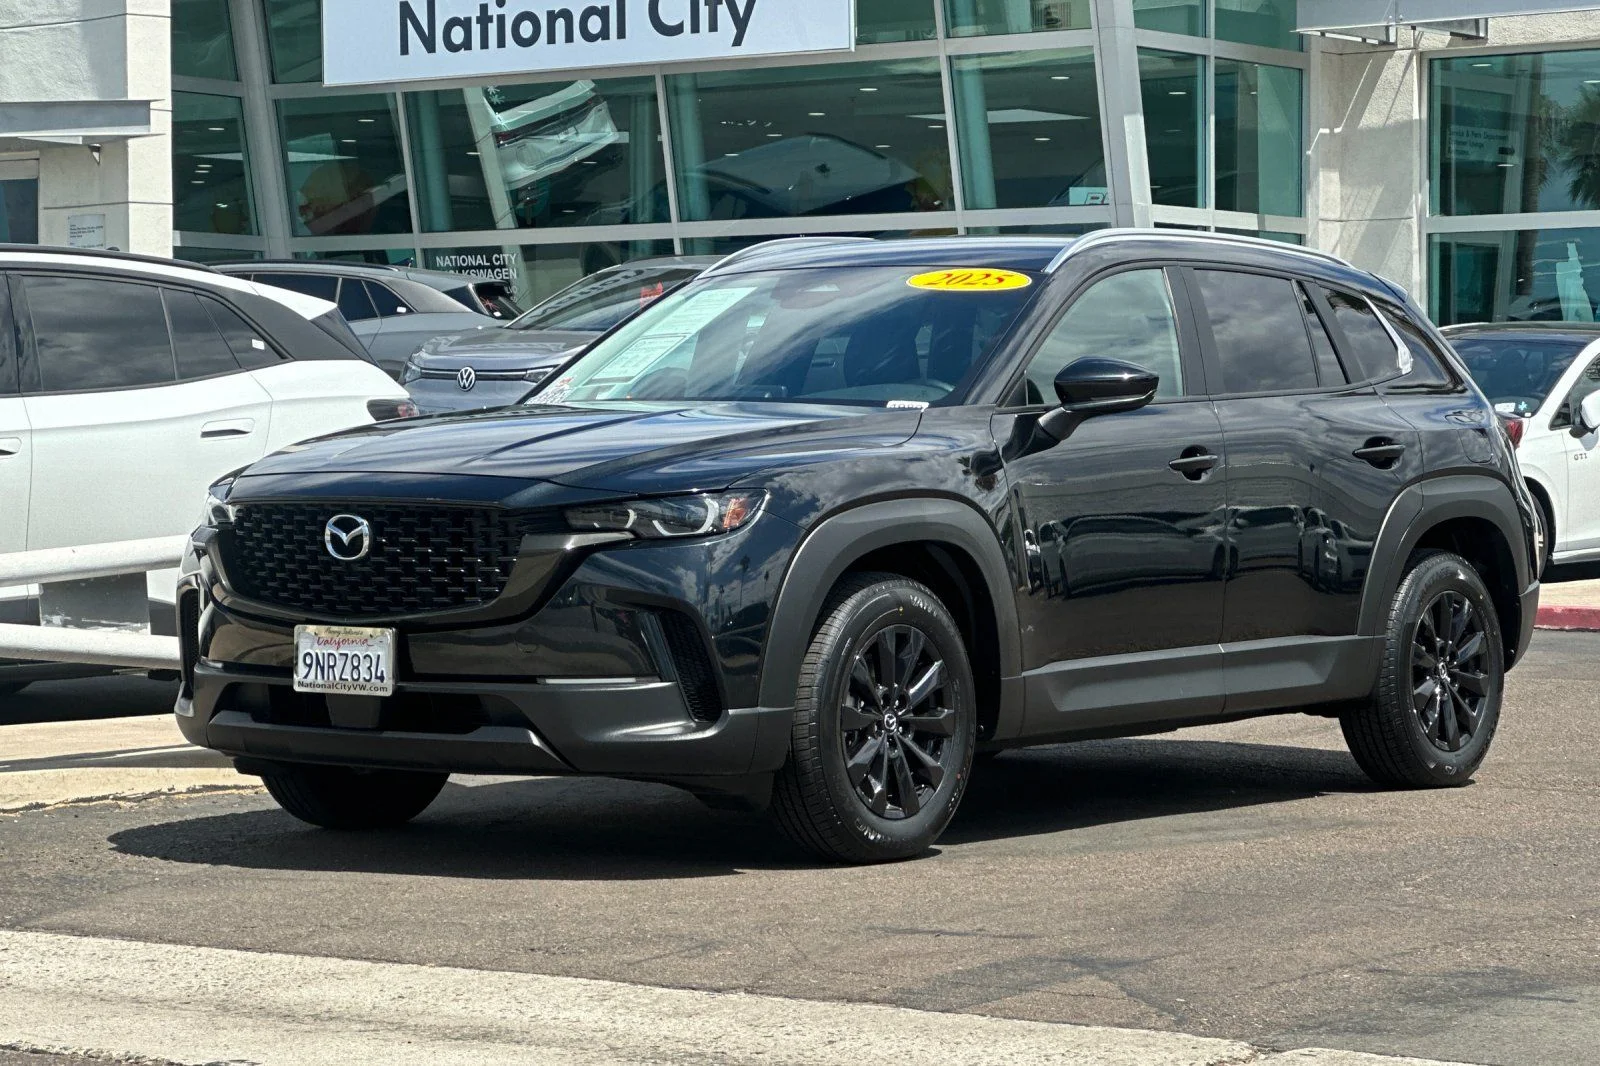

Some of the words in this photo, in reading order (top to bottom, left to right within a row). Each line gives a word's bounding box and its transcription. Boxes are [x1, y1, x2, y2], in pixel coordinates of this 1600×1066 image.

[399, 0, 626, 55] National
[647, 0, 757, 47] City
[436, 254, 490, 267] NATIONAL
[492, 253, 517, 266] CITY
[923, 272, 1014, 286] 2025
[317, 636, 374, 650] California
[302, 651, 385, 683] 9NRZ834
[297, 680, 388, 693] NationalCityVW.com
